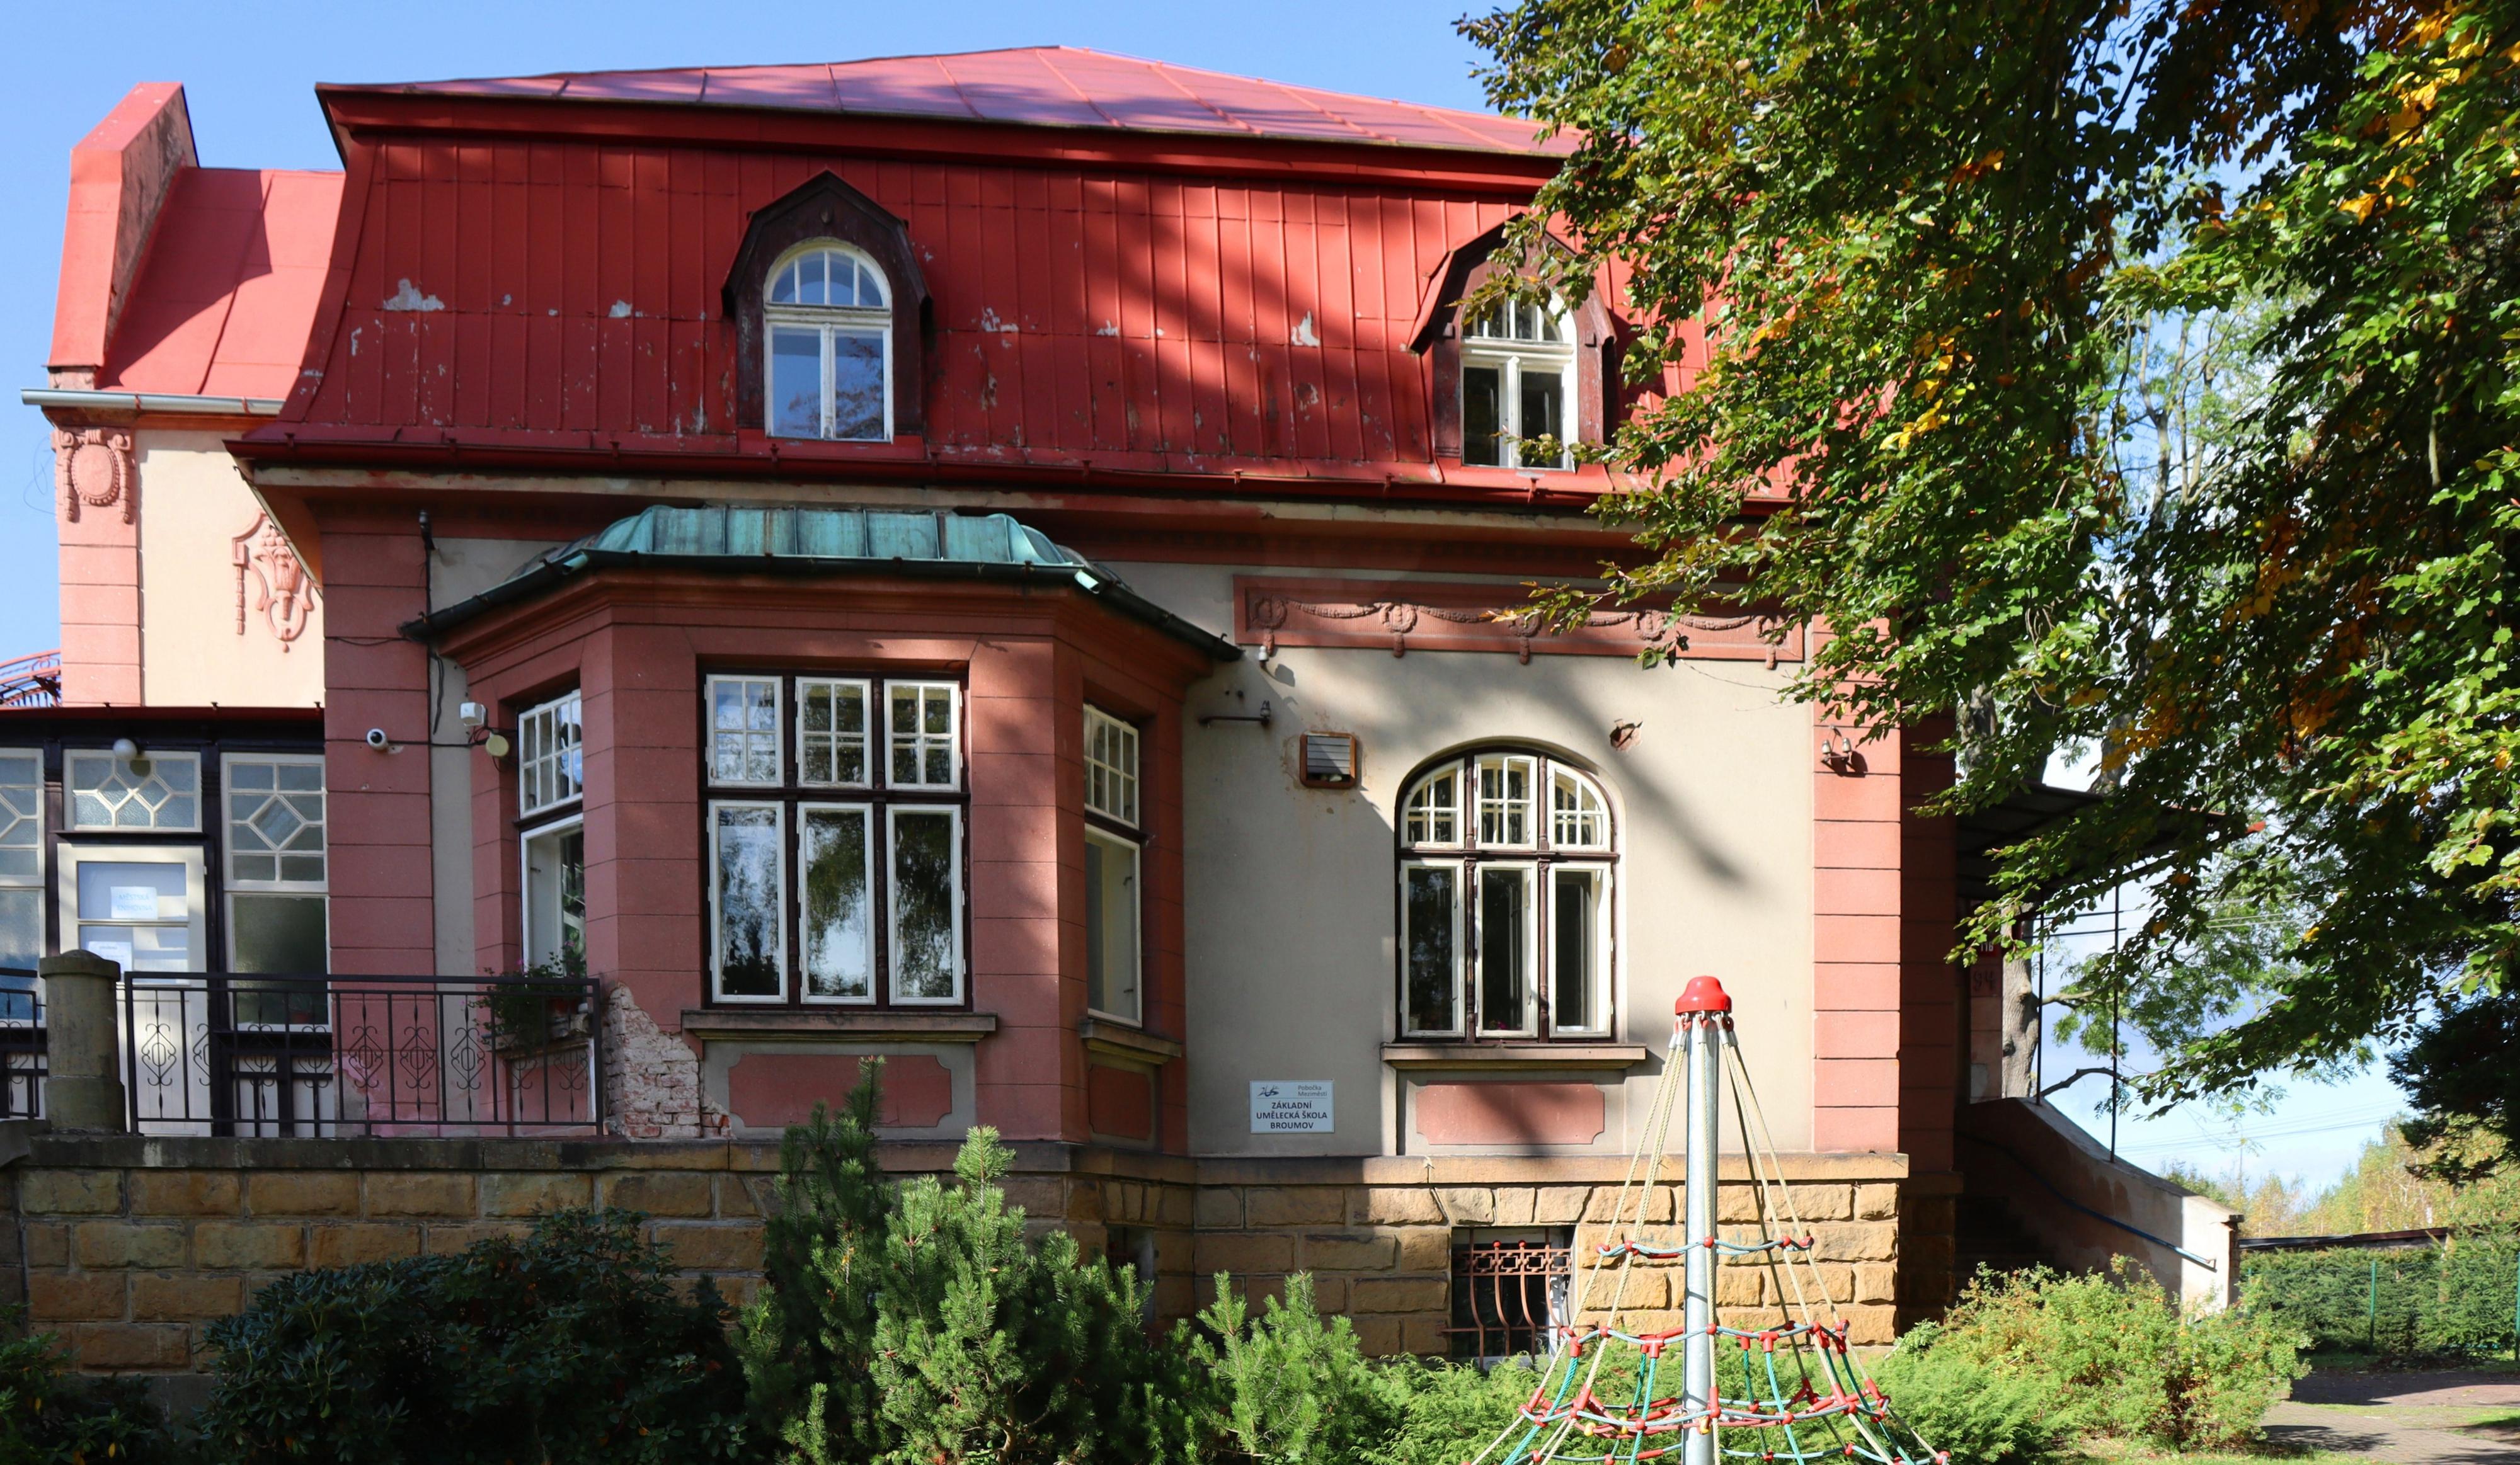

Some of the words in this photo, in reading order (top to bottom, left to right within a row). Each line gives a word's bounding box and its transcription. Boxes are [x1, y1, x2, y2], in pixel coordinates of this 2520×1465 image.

[1271, 1100, 1312, 1109] ZÁKLADNÍ
[1256, 1110, 1300, 1119] UMĚLECKÁ
[1302, 1110, 1327, 1119] ŠKOLA
